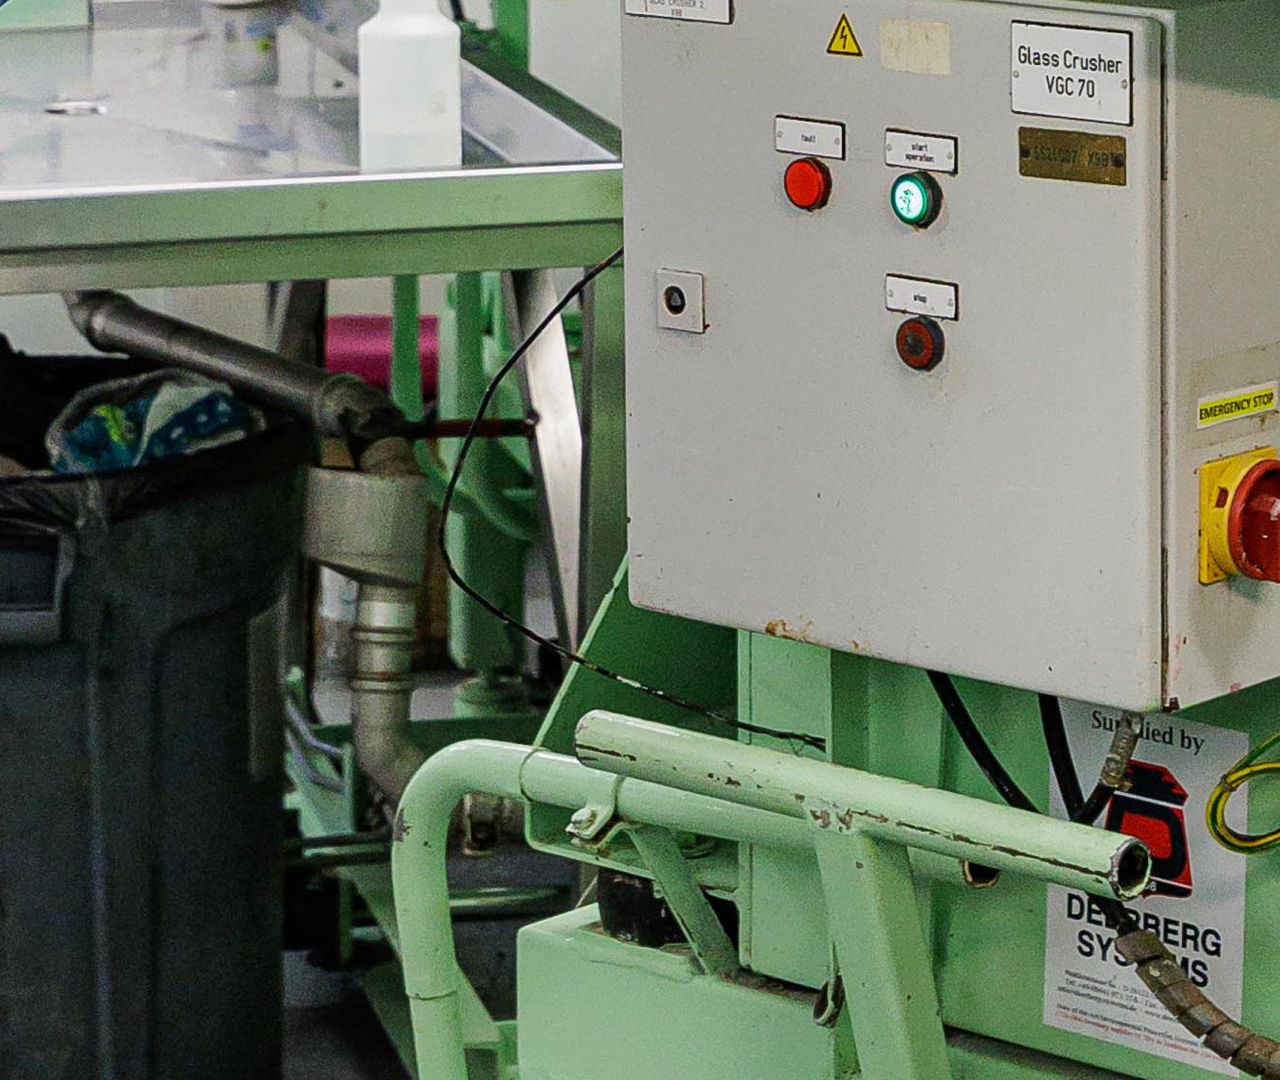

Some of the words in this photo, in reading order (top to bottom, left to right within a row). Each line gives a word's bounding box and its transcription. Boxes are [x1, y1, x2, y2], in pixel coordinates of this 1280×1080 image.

[1017, 45, 1060, 68] Glass
[1063, 49, 1123, 74] Crusher
[1046, 75, 1074, 96] VGC
[1078, 78, 1095, 98] 70
[904, 152, 935, 163] operation
[911, 143, 928, 152] start
[1199, 397, 1252, 420] EMERGENCY
[1252, 392, 1274, 408] STOP
[1091, 710, 1174, 746] Sulied
[1180, 729, 1205, 756] by
[1067, 893, 1222, 958] DERBERG
